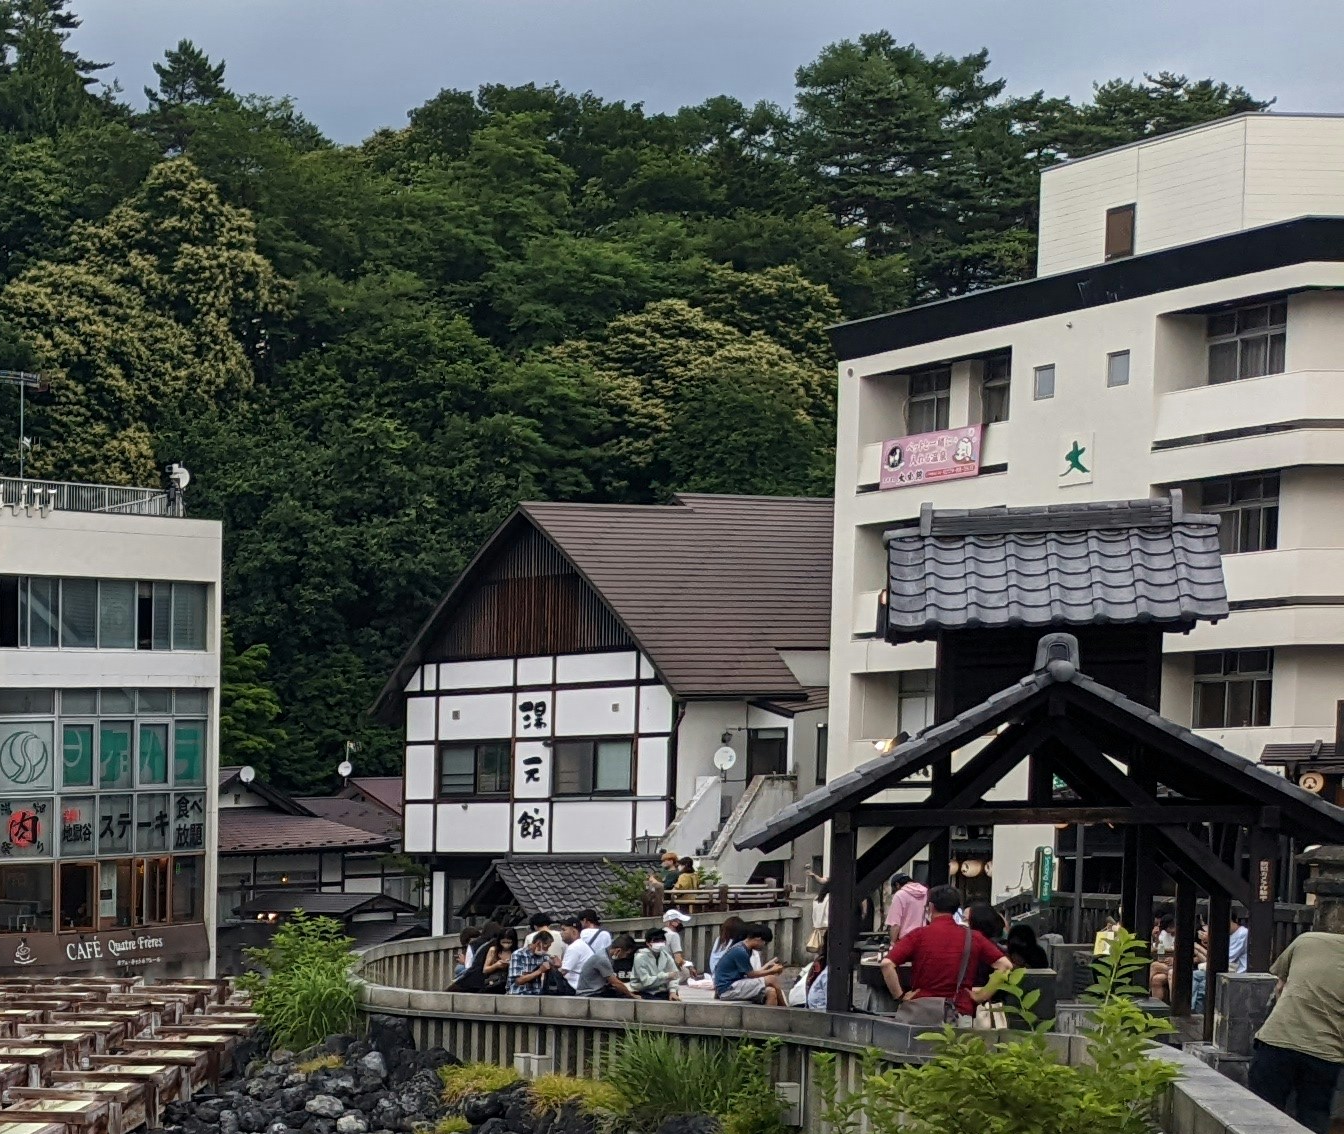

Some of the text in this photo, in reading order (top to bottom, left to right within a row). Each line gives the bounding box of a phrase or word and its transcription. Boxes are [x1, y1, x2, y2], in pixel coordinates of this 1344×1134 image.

[518, 701, 548, 840] 湯元館
[9, 811, 39, 845] 肉
[100, 811, 170, 839] ステーキ
[176, 823, 204, 847] 放題
[66, 936, 104, 960] CAFÉ
[108, 939, 137, 956] Quatre
